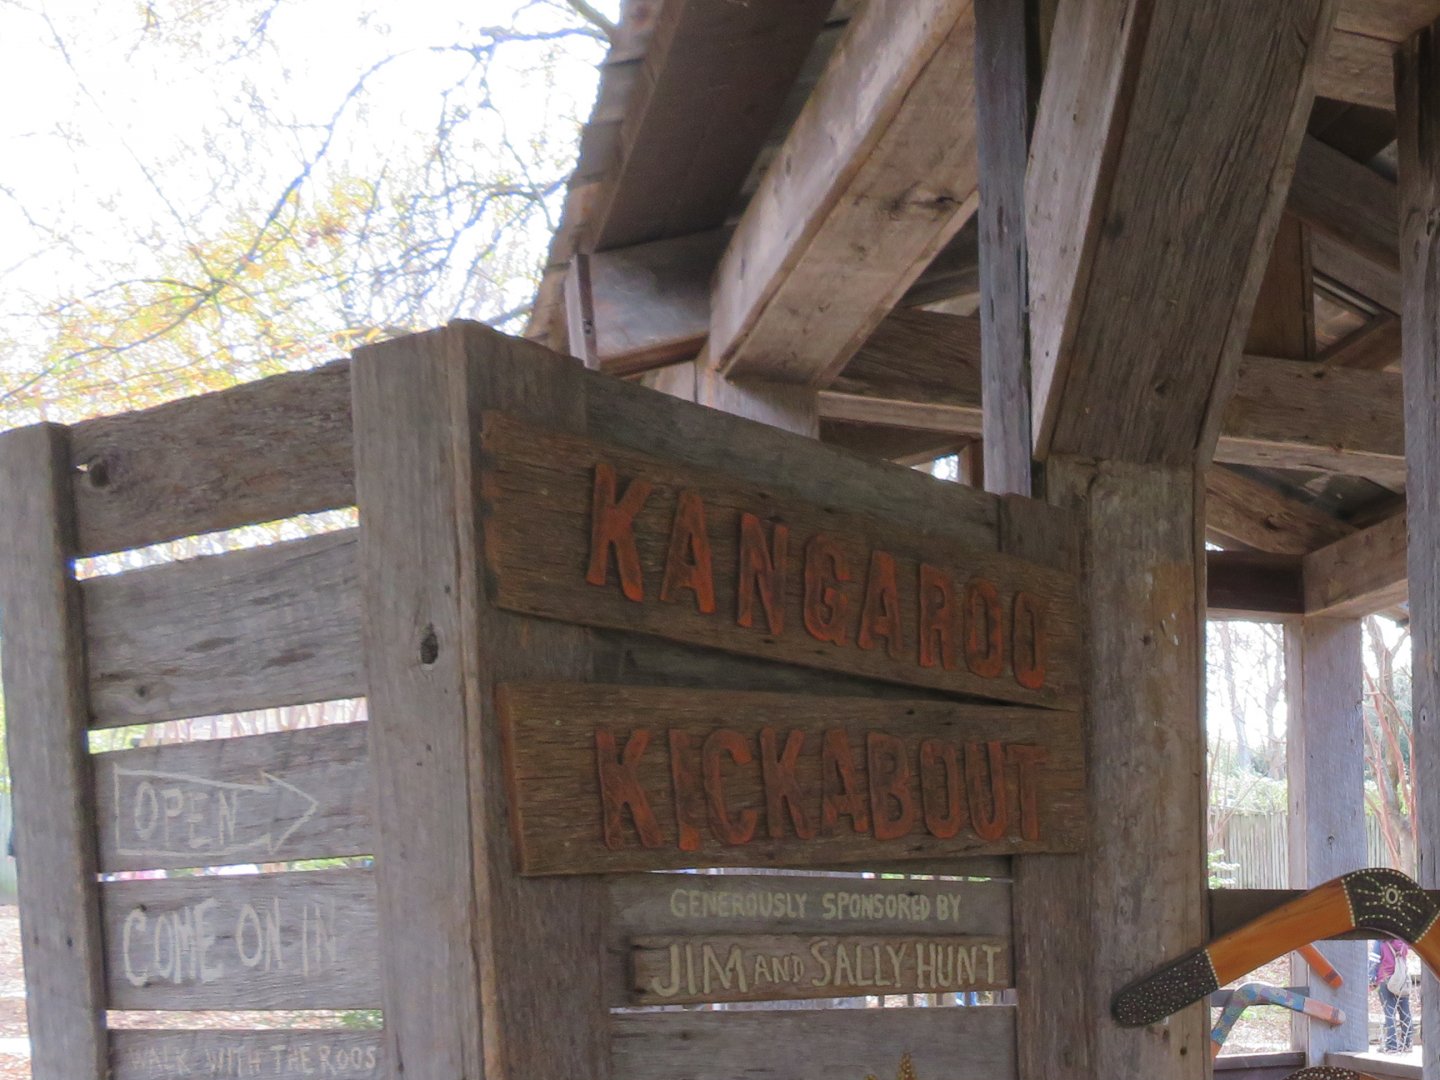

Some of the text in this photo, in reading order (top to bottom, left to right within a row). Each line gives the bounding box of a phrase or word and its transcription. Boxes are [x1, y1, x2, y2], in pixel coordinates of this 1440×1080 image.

[585, 462, 1046, 688] KANGAROO
[133, 781, 238, 849] OPEN
[594, 726, 1049, 850] KICKABOUT
[670, 888, 961, 922] GENEROUSLY SPONSORED BY
[123, 896, 337, 987] COME ON IN
[651, 939, 1004, 997] JIM AND SALLY HUNT
[205, 1045, 262, 1077] WITH
[271, 1045, 314, 1075] THE
[318, 1045, 376, 1076] ROOS
